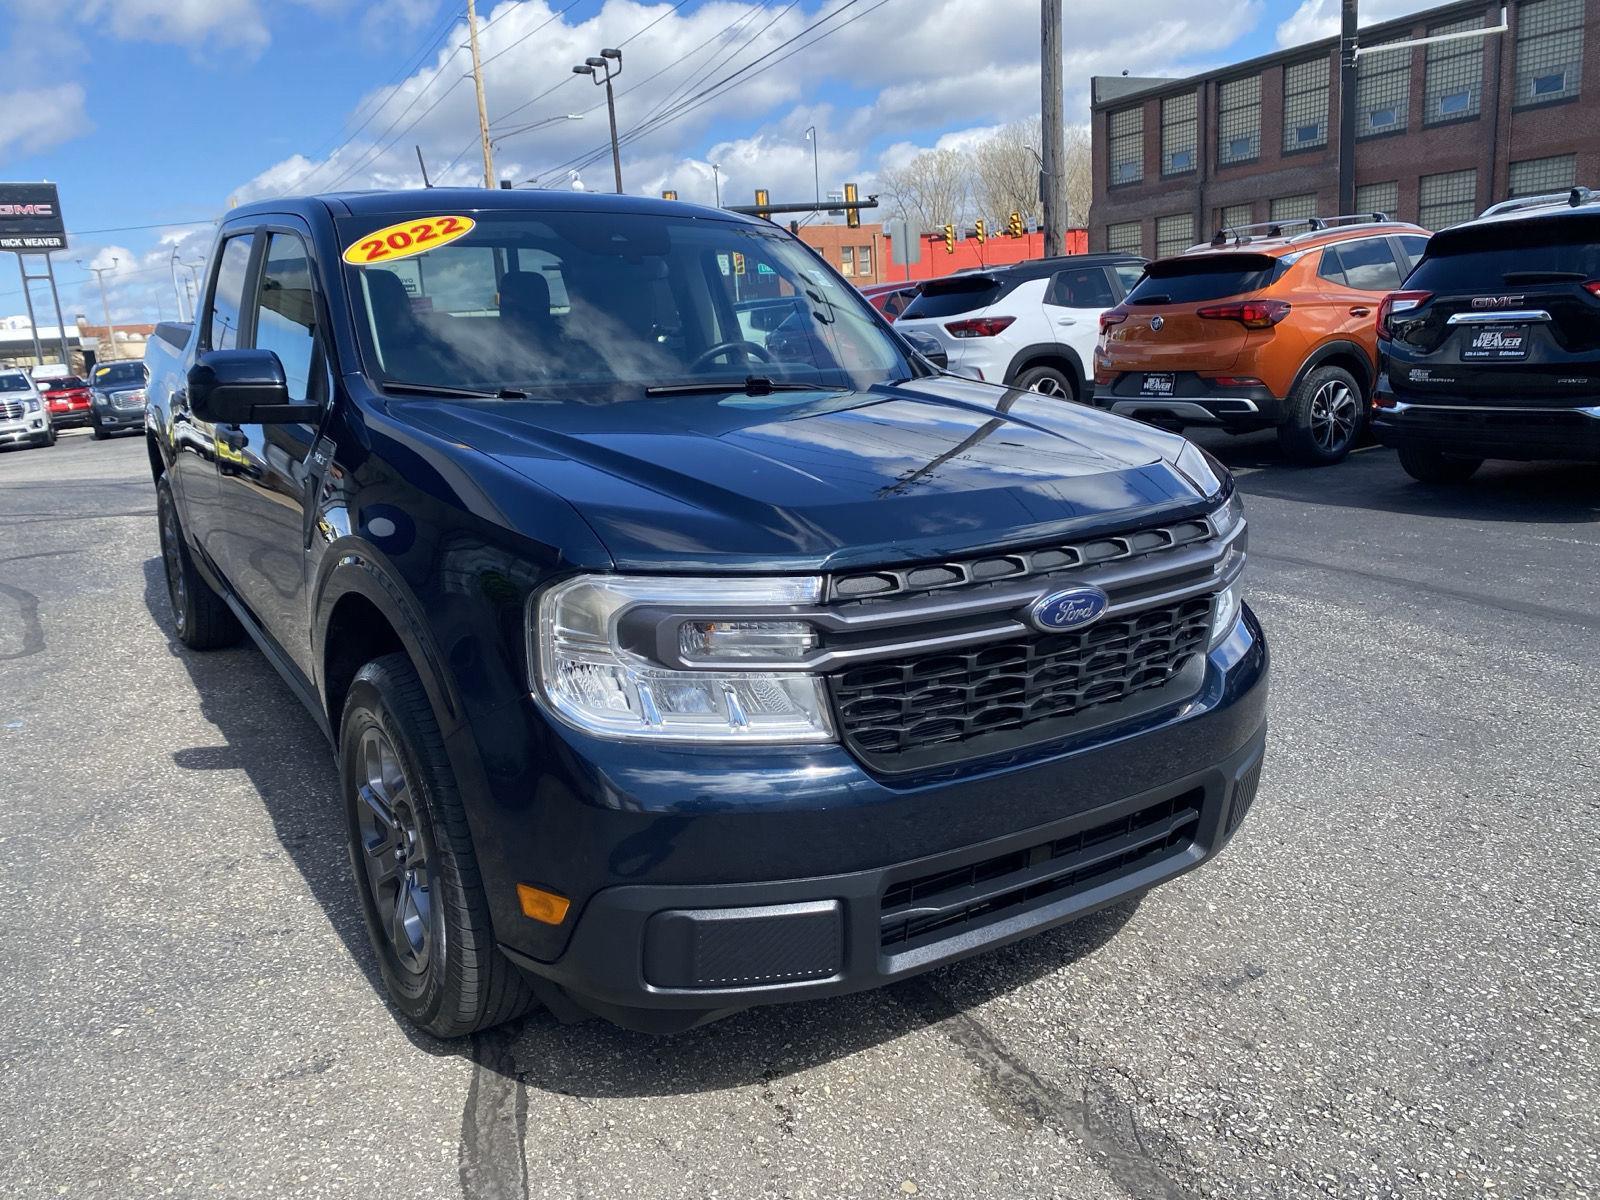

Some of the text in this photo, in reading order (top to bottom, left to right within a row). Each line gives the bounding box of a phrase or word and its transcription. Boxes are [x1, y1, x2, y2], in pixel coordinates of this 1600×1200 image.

[0, 204, 53, 215] GMC
[0, 237, 61, 247] RICK WEAVER
[360, 216, 465, 261] 2022
[1471, 294, 1525, 309] GMC
[1479, 331, 1504, 341] RICK
[1472, 337, 1523, 348] WEAVER
[1054, 598, 1095, 624] Ford
